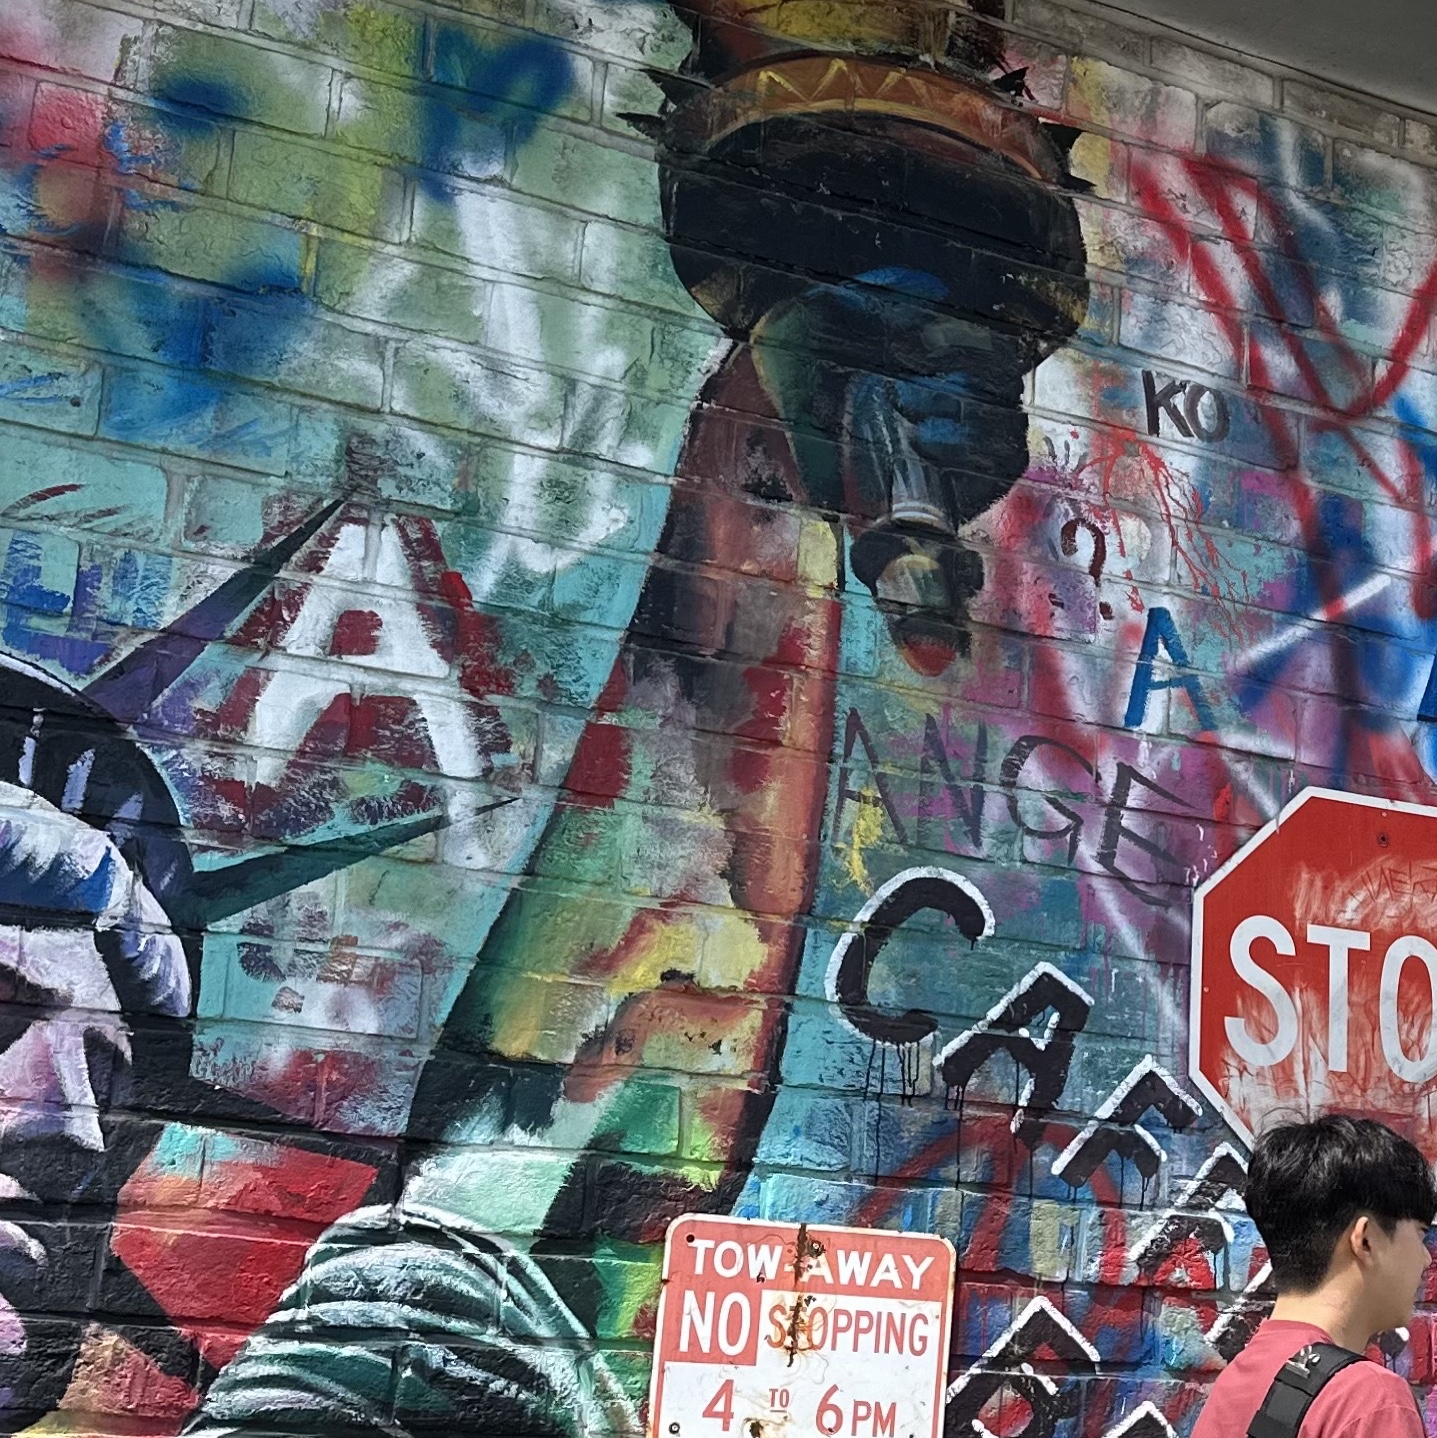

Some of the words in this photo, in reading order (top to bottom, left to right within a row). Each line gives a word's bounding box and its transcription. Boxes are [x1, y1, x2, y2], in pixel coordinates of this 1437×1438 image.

[1142, 369, 1231, 444] KO
[687, 1239, 935, 1290] TOW-AWAY
[679, 1289, 751, 1356] NO
[702, 1378, 735, 1431] 4
[768, 1388, 790, 1408] TO
[815, 1383, 844, 1437] 6
[850, 1399, 897, 1438] PM
